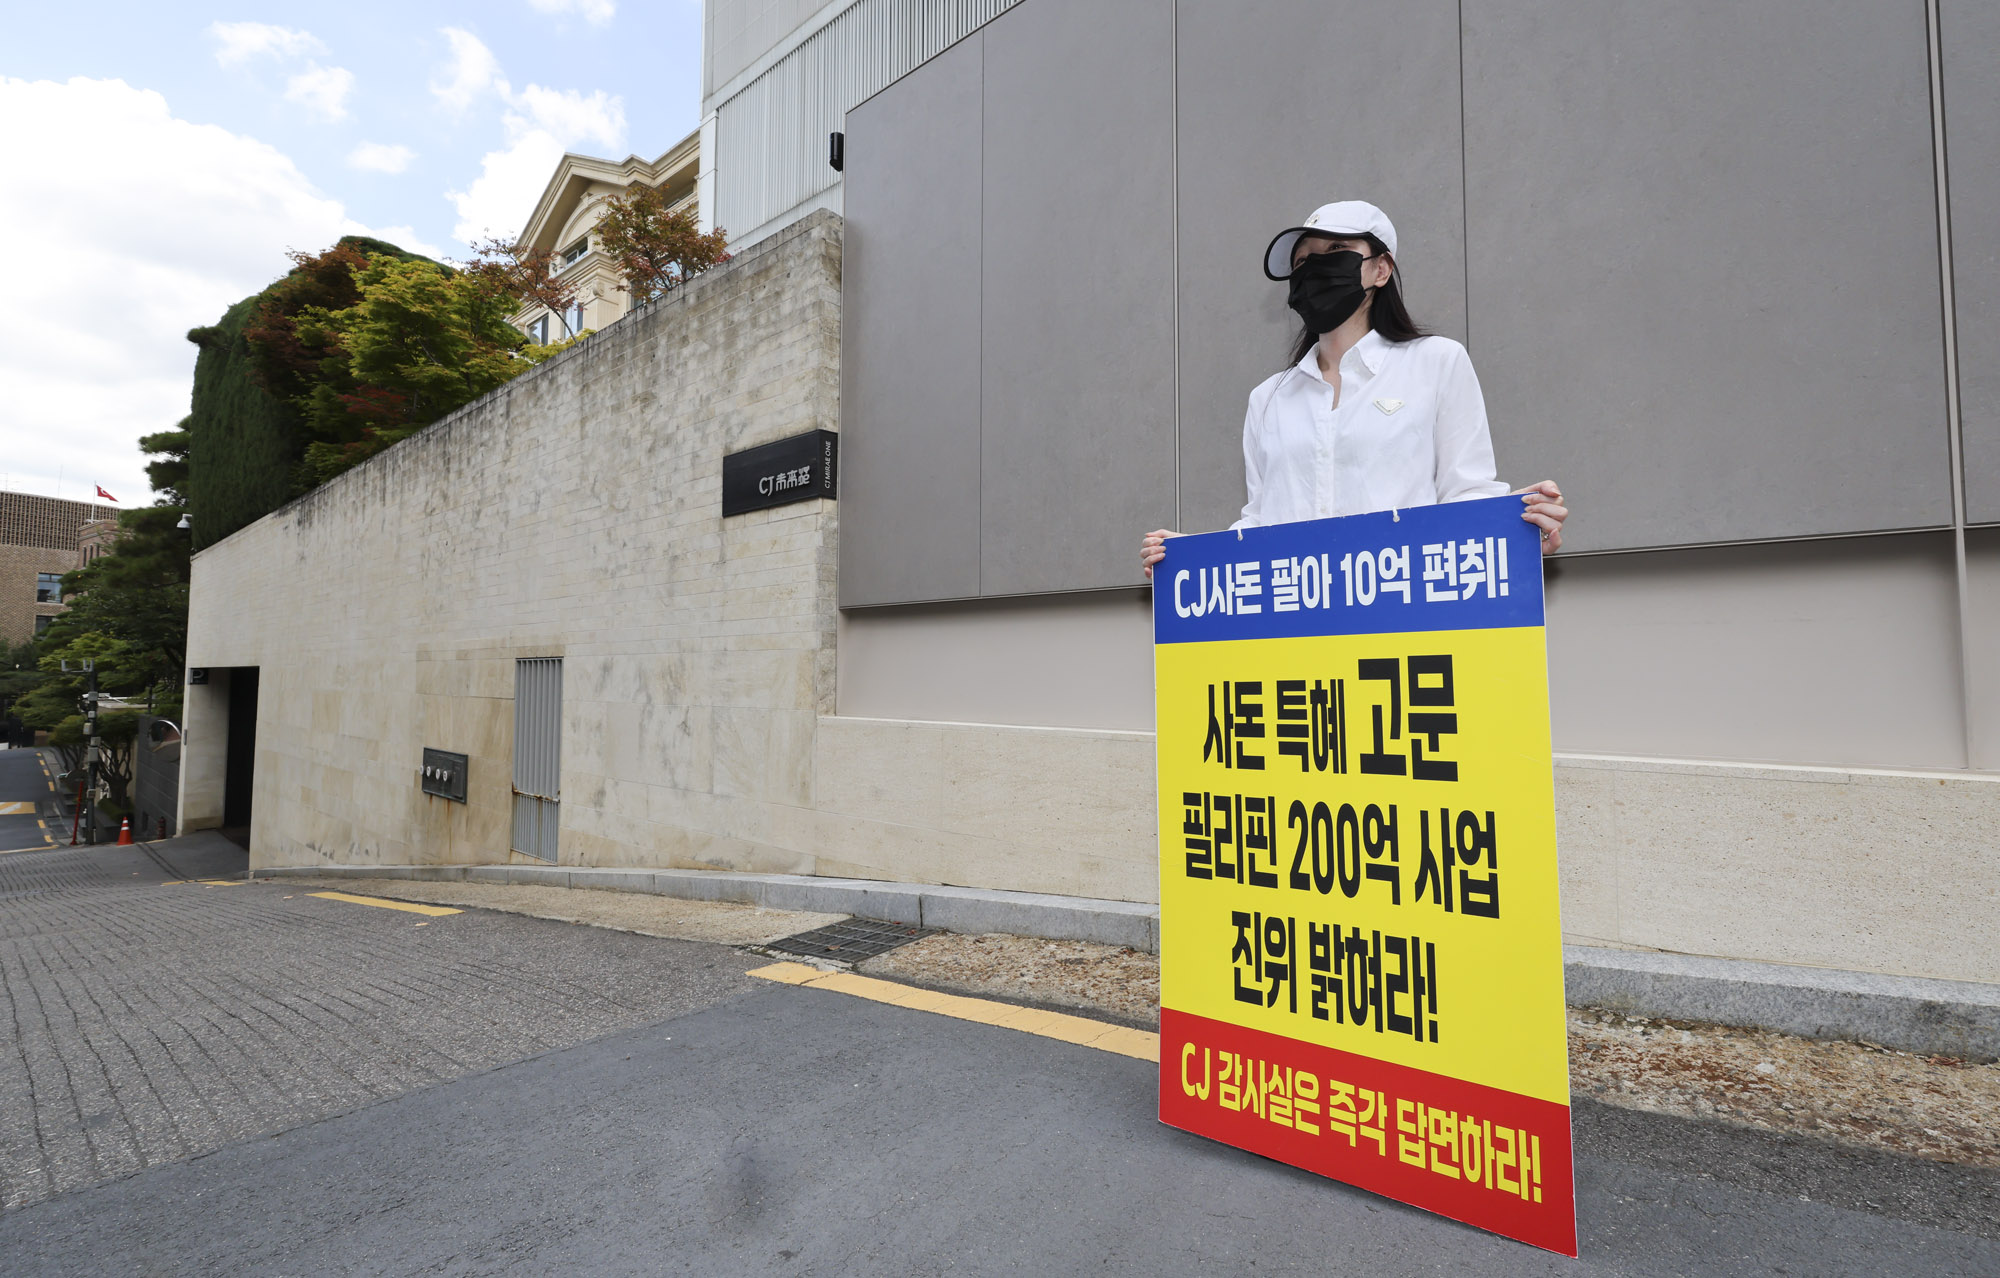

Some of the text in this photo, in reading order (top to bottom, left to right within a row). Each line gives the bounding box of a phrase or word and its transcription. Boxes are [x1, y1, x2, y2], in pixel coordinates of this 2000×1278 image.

[759, 476, 774, 497] CJ
[824, 440, 832, 457] ONE
[1174, 536, 1509, 619] CJ사돈 팔아 10억 편취!
[1203, 654, 1459, 782] 사돈 특혜 고문
[1182, 791, 1500, 919] 필리핀 200억 사업
[1231, 910, 1439, 1044] 진위 밝혀라!
[1181, 1042, 1543, 1204] CJ 감사실은 즉각 답면하라!
